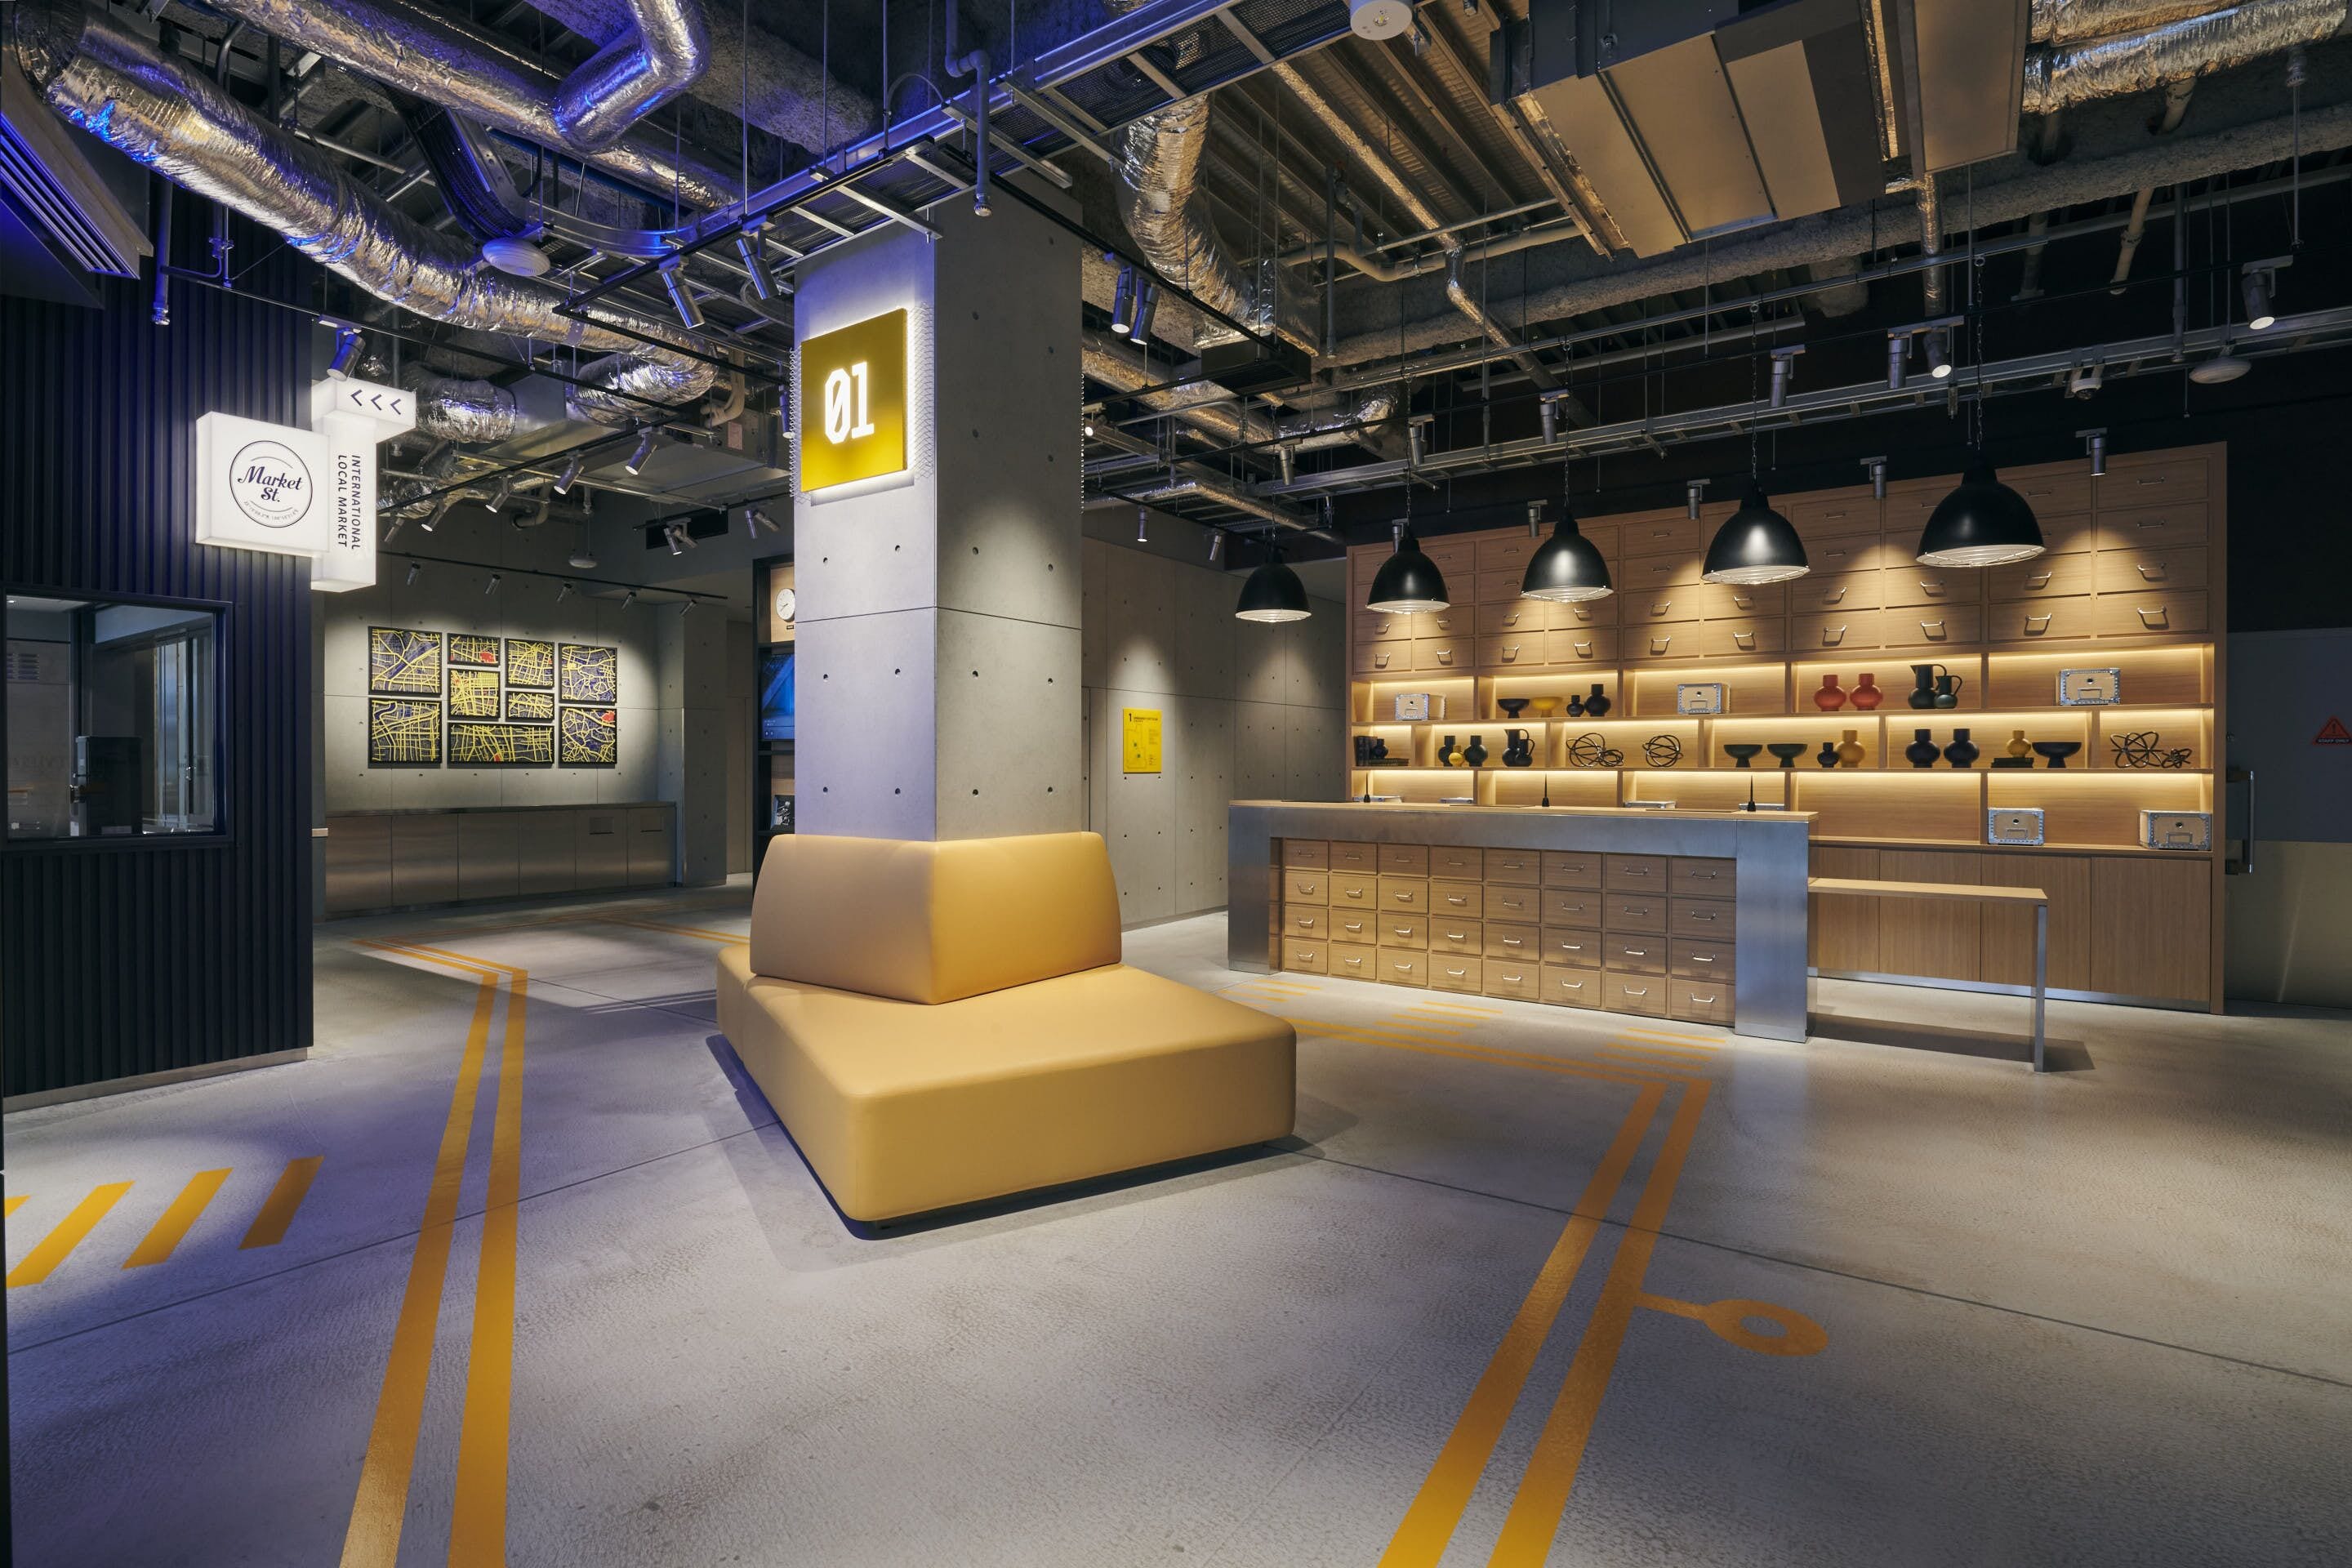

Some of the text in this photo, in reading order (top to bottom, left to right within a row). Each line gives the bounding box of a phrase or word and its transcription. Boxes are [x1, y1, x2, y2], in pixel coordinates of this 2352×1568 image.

[824, 361, 875, 444] 01
[237, 466, 302, 491] Market
[261, 487, 280, 502] St.
[338, 455, 348, 547] LOCAL MARKET
[351, 455, 361, 550] INTERNATIONAL
